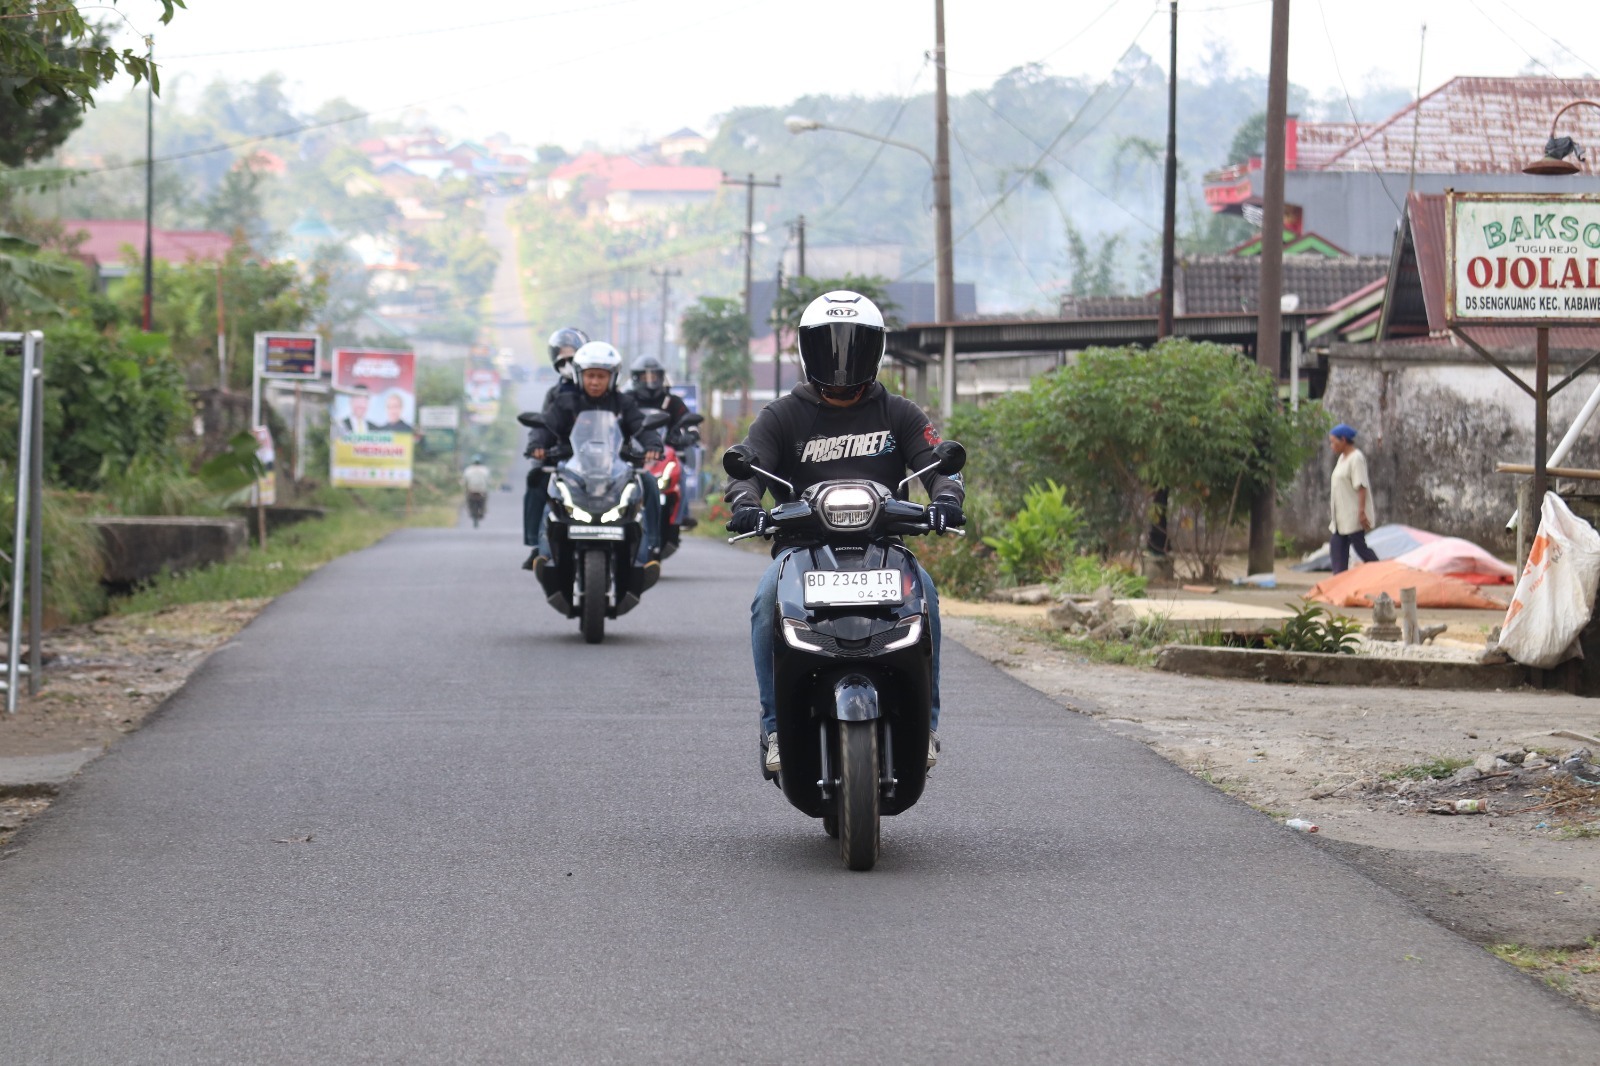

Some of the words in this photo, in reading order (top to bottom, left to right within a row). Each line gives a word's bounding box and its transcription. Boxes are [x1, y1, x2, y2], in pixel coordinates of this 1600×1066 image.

[1482, 213, 1600, 250] BAKSO
[1515, 245, 1546, 254] TUGU
[1549, 245, 1578, 254] REJO
[1465, 296, 1536, 311] DS.SENGKUANG
[1539, 296, 1560, 311] KEC.
[800, 430, 891, 463] PROSTREET
[807, 573, 826, 587] BD
[832, 573, 868, 587] 2348
[877, 572, 893, 585] IR
